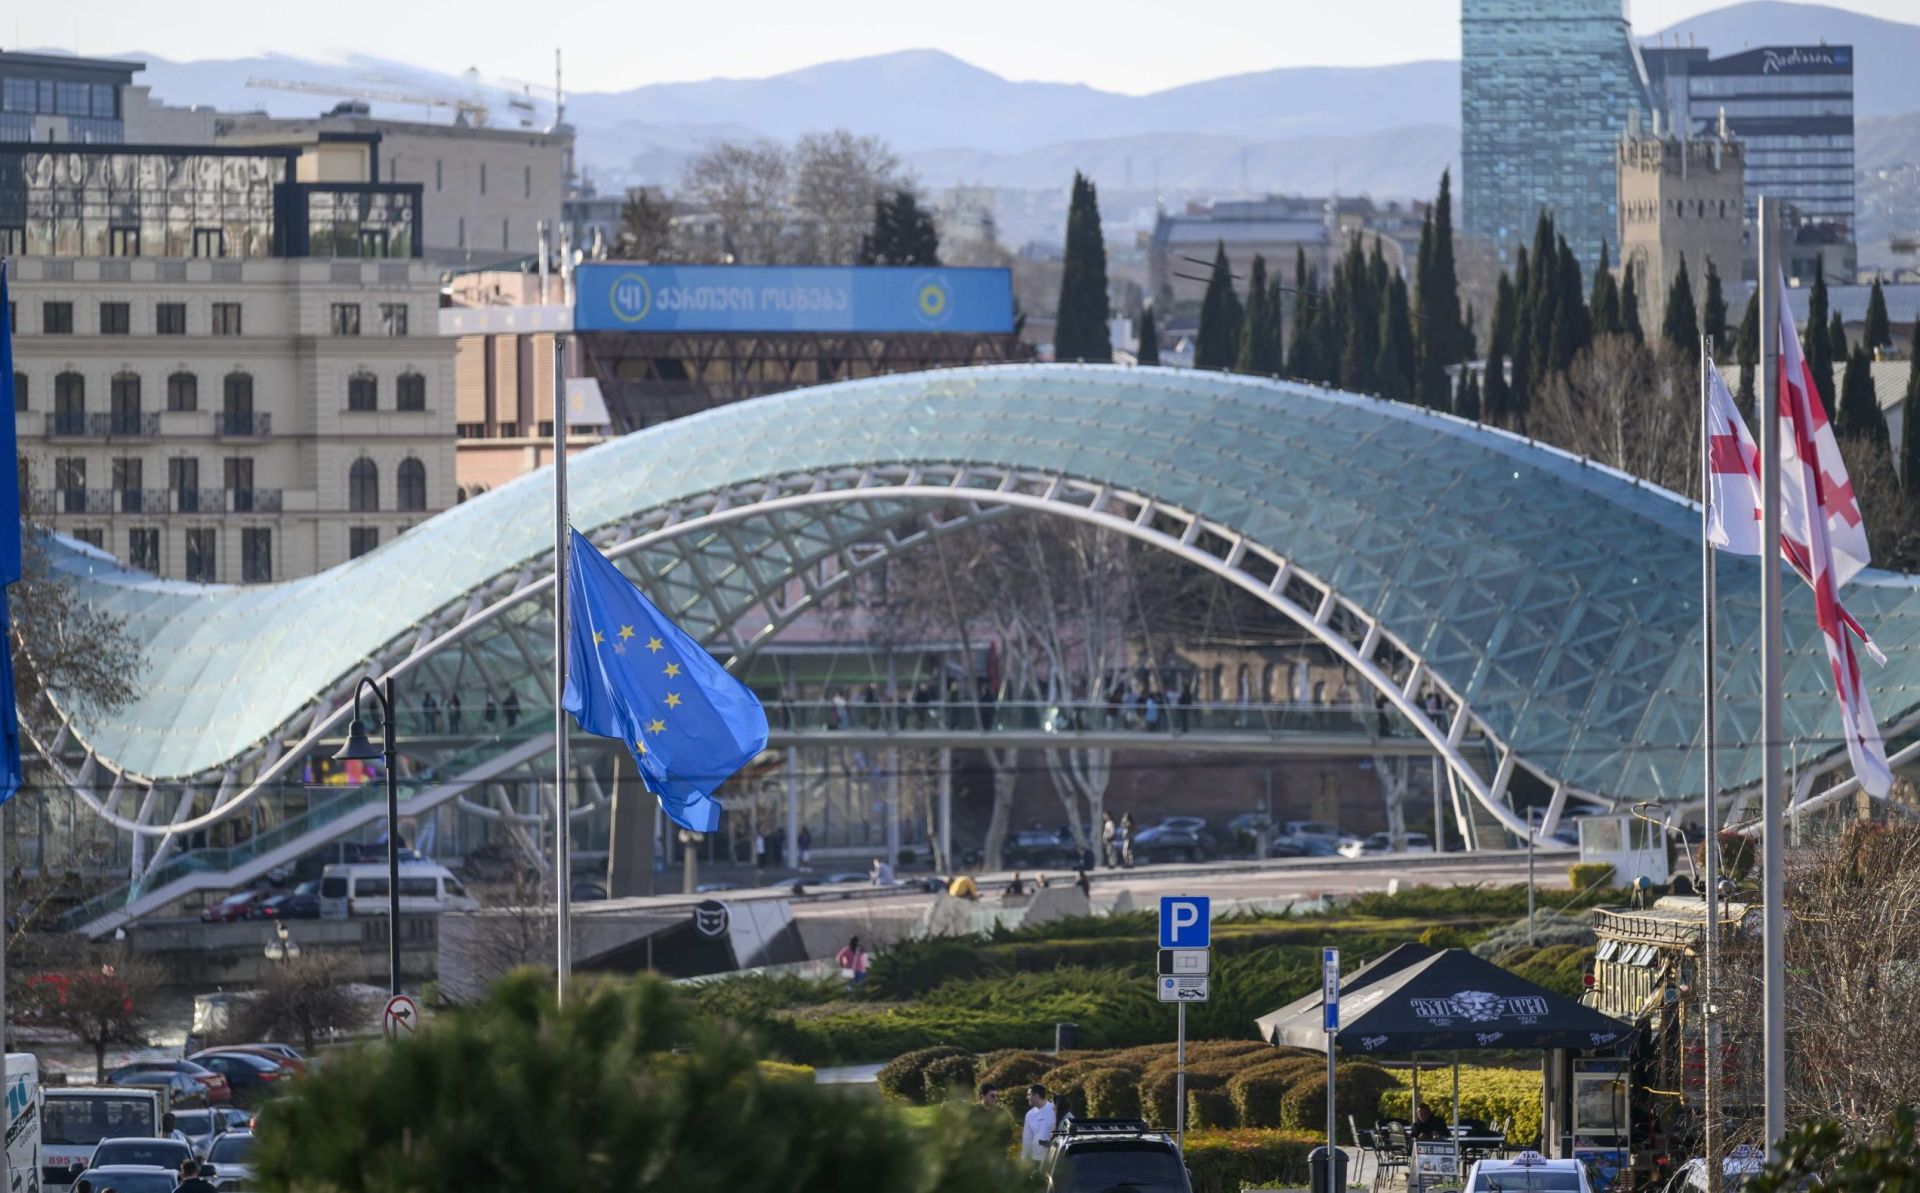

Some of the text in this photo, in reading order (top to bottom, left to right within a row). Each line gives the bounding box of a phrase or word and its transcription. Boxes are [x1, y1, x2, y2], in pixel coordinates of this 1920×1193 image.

[618, 285, 848, 311] 41 ქართული ოცნება
[1171, 902, 1199, 942] P
